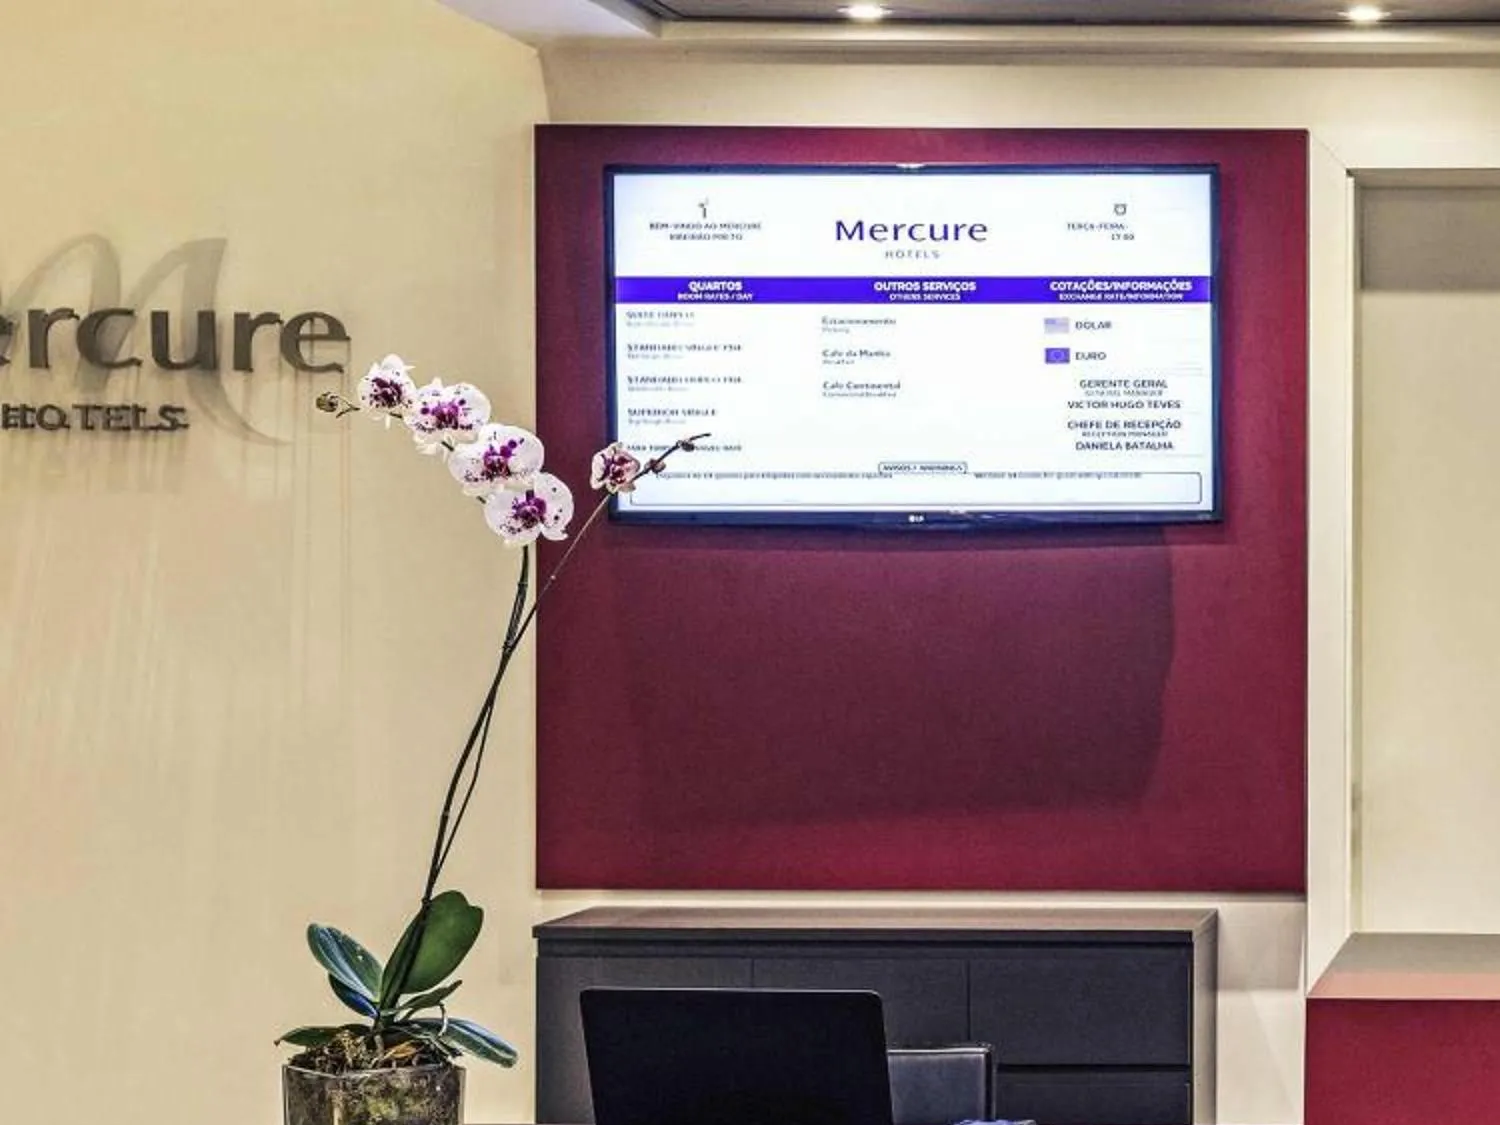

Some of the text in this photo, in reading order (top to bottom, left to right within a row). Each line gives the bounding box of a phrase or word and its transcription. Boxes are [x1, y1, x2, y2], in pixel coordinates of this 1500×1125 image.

[835, 219, 988, 242] Mercure
[885, 250, 940, 259] HOTELS
[688, 281, 743, 292] QUARTOS
[873, 281, 976, 293] OUTROS SERVIÇOS
[1050, 278, 1193, 293] COTAÇÕES/INFORMAÇÕES
[1075, 351, 1106, 360] EURO
[1079, 379, 1168, 389] GERENTE GERAL
[1067, 400, 1181, 409] VICTOR HUGO TEVES
[1, 402, 190, 431] HOTELS
[1067, 419, 1102, 429] CHEFE
[1105, 420, 1121, 429] DE
[1075, 441, 1174, 451] DANIELA BATALHA
